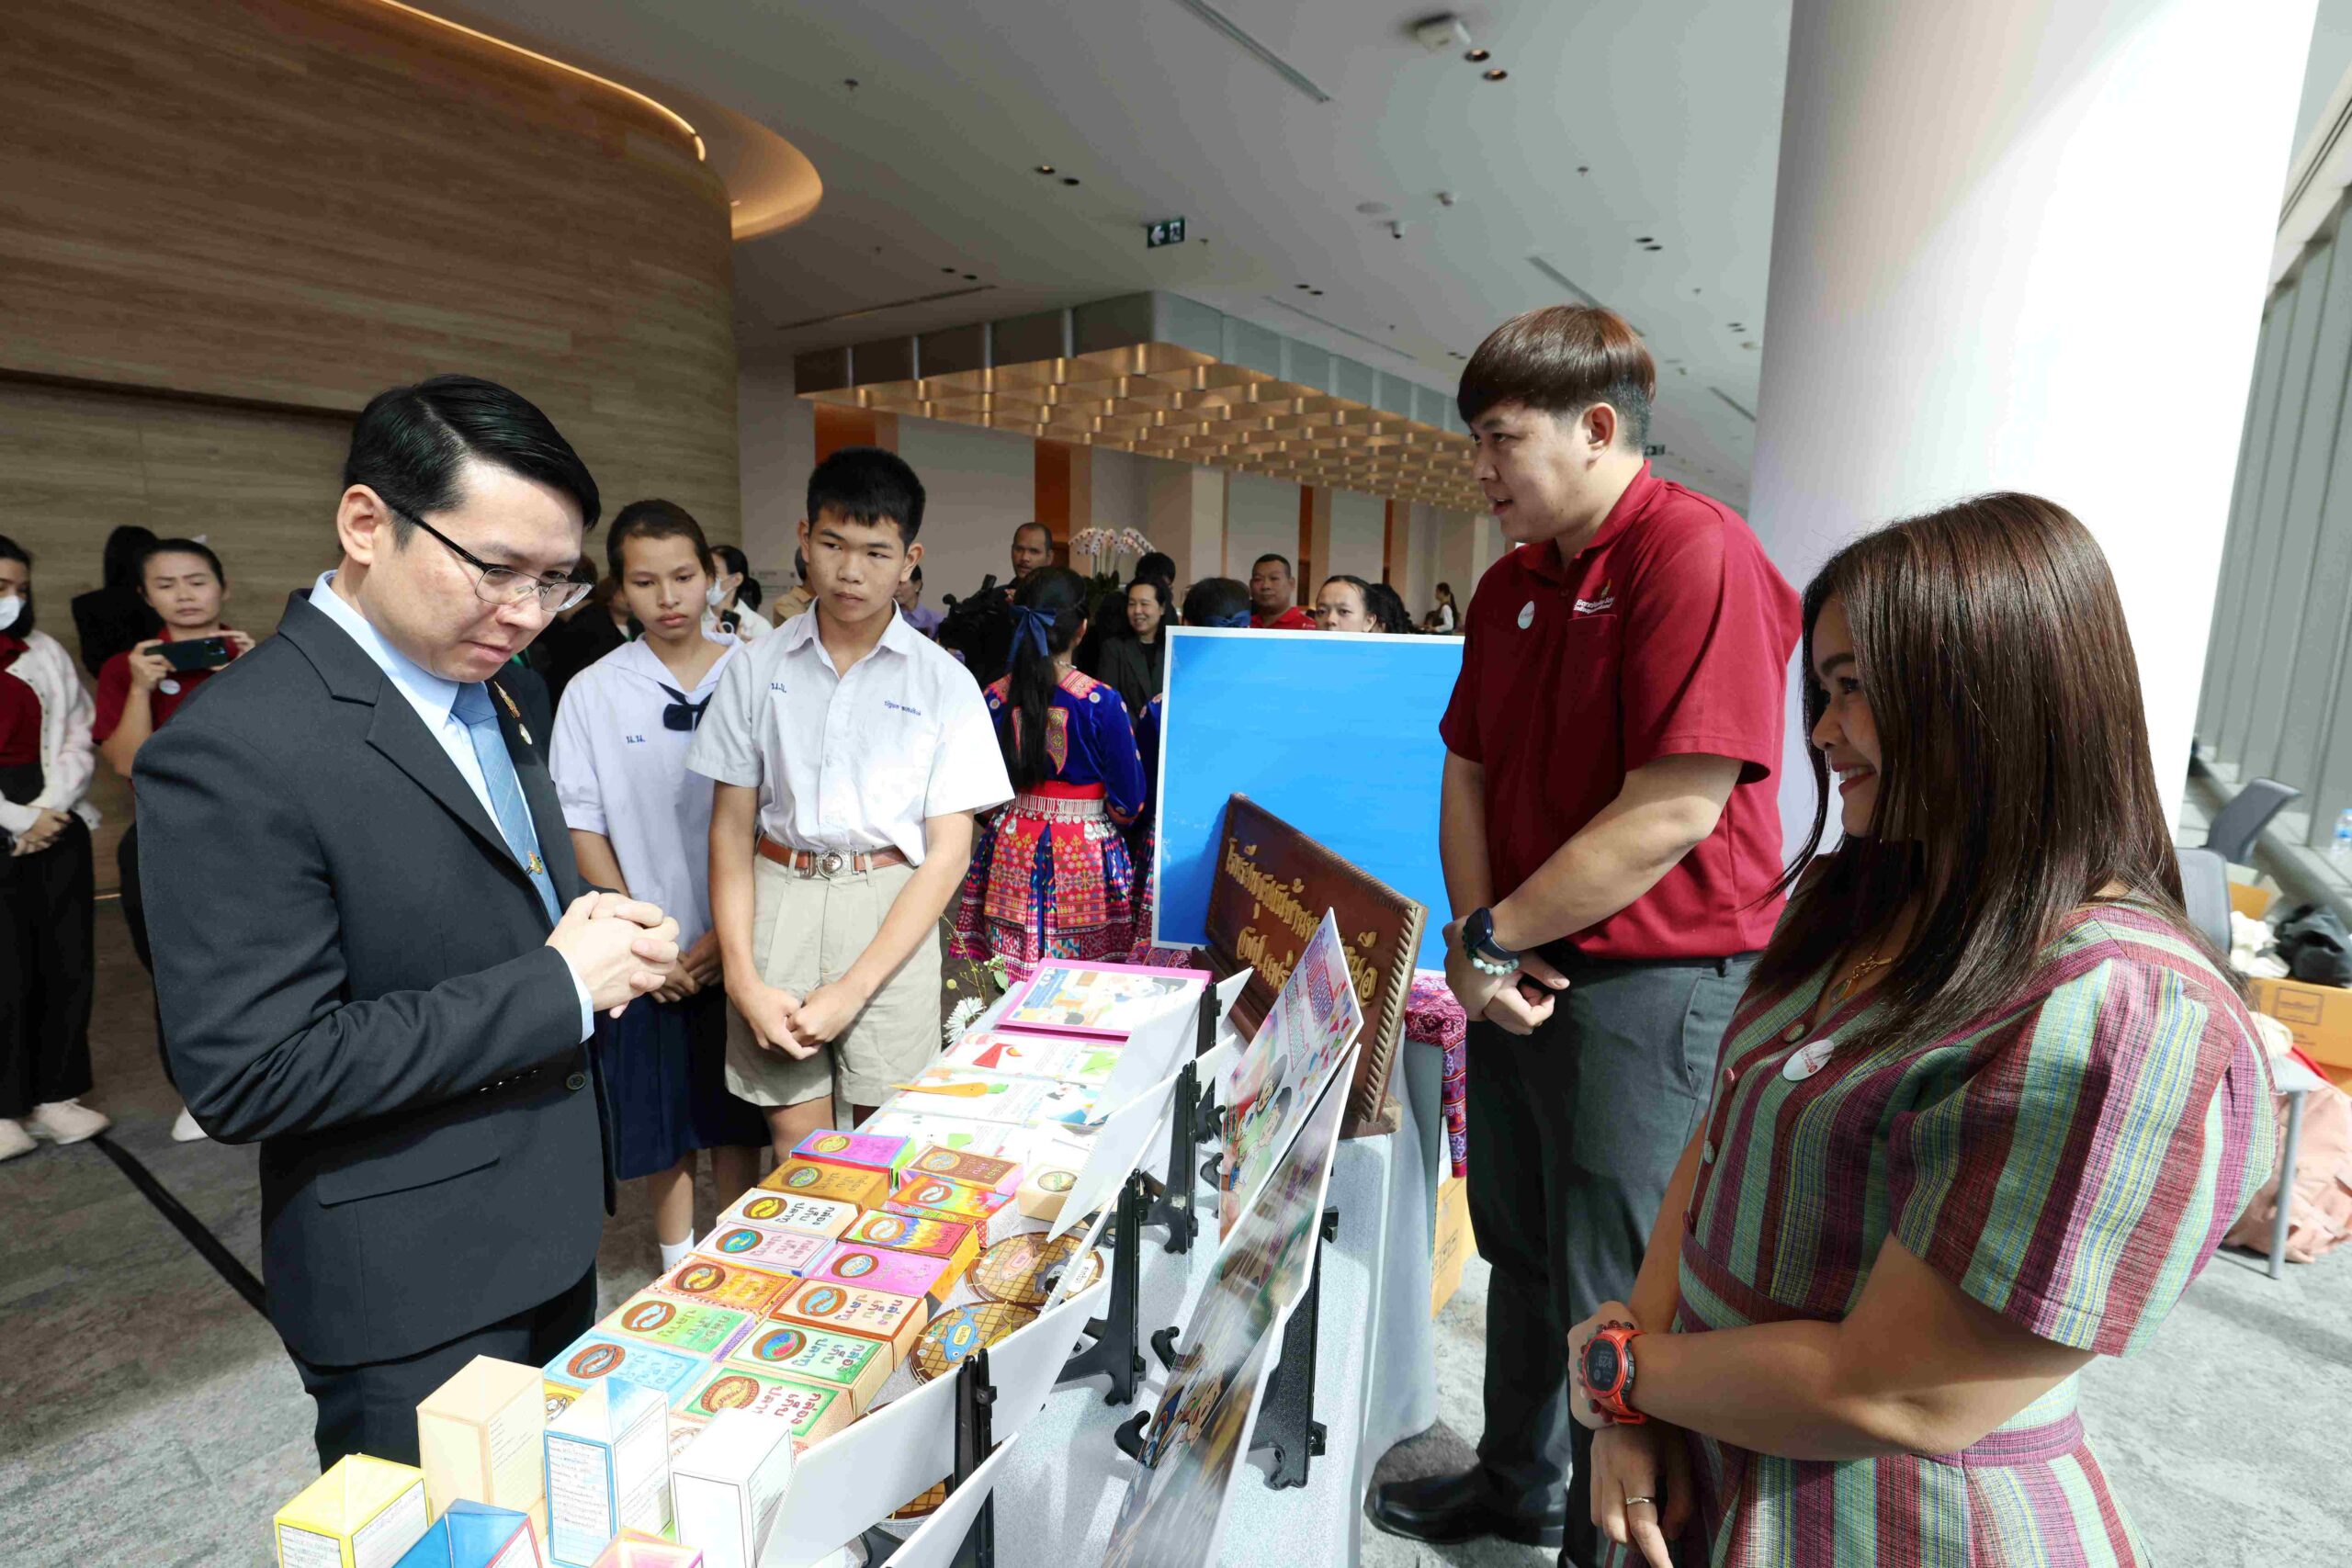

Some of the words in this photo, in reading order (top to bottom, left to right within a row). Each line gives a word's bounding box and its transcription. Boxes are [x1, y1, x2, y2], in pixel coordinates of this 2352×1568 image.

[799, 1206, 819, 1222] เก็บ
[812, 1206, 835, 1225] กล่อง
[863, 1300, 885, 1319] เก็บ
[877, 1299, 903, 1325] กล่อง
[820, 1344, 846, 1365] เก็บ
[837, 1344, 865, 1374] กล่อง
[775, 1393, 799, 1416] เก็บ
[790, 1392, 822, 1425] กล่อง
